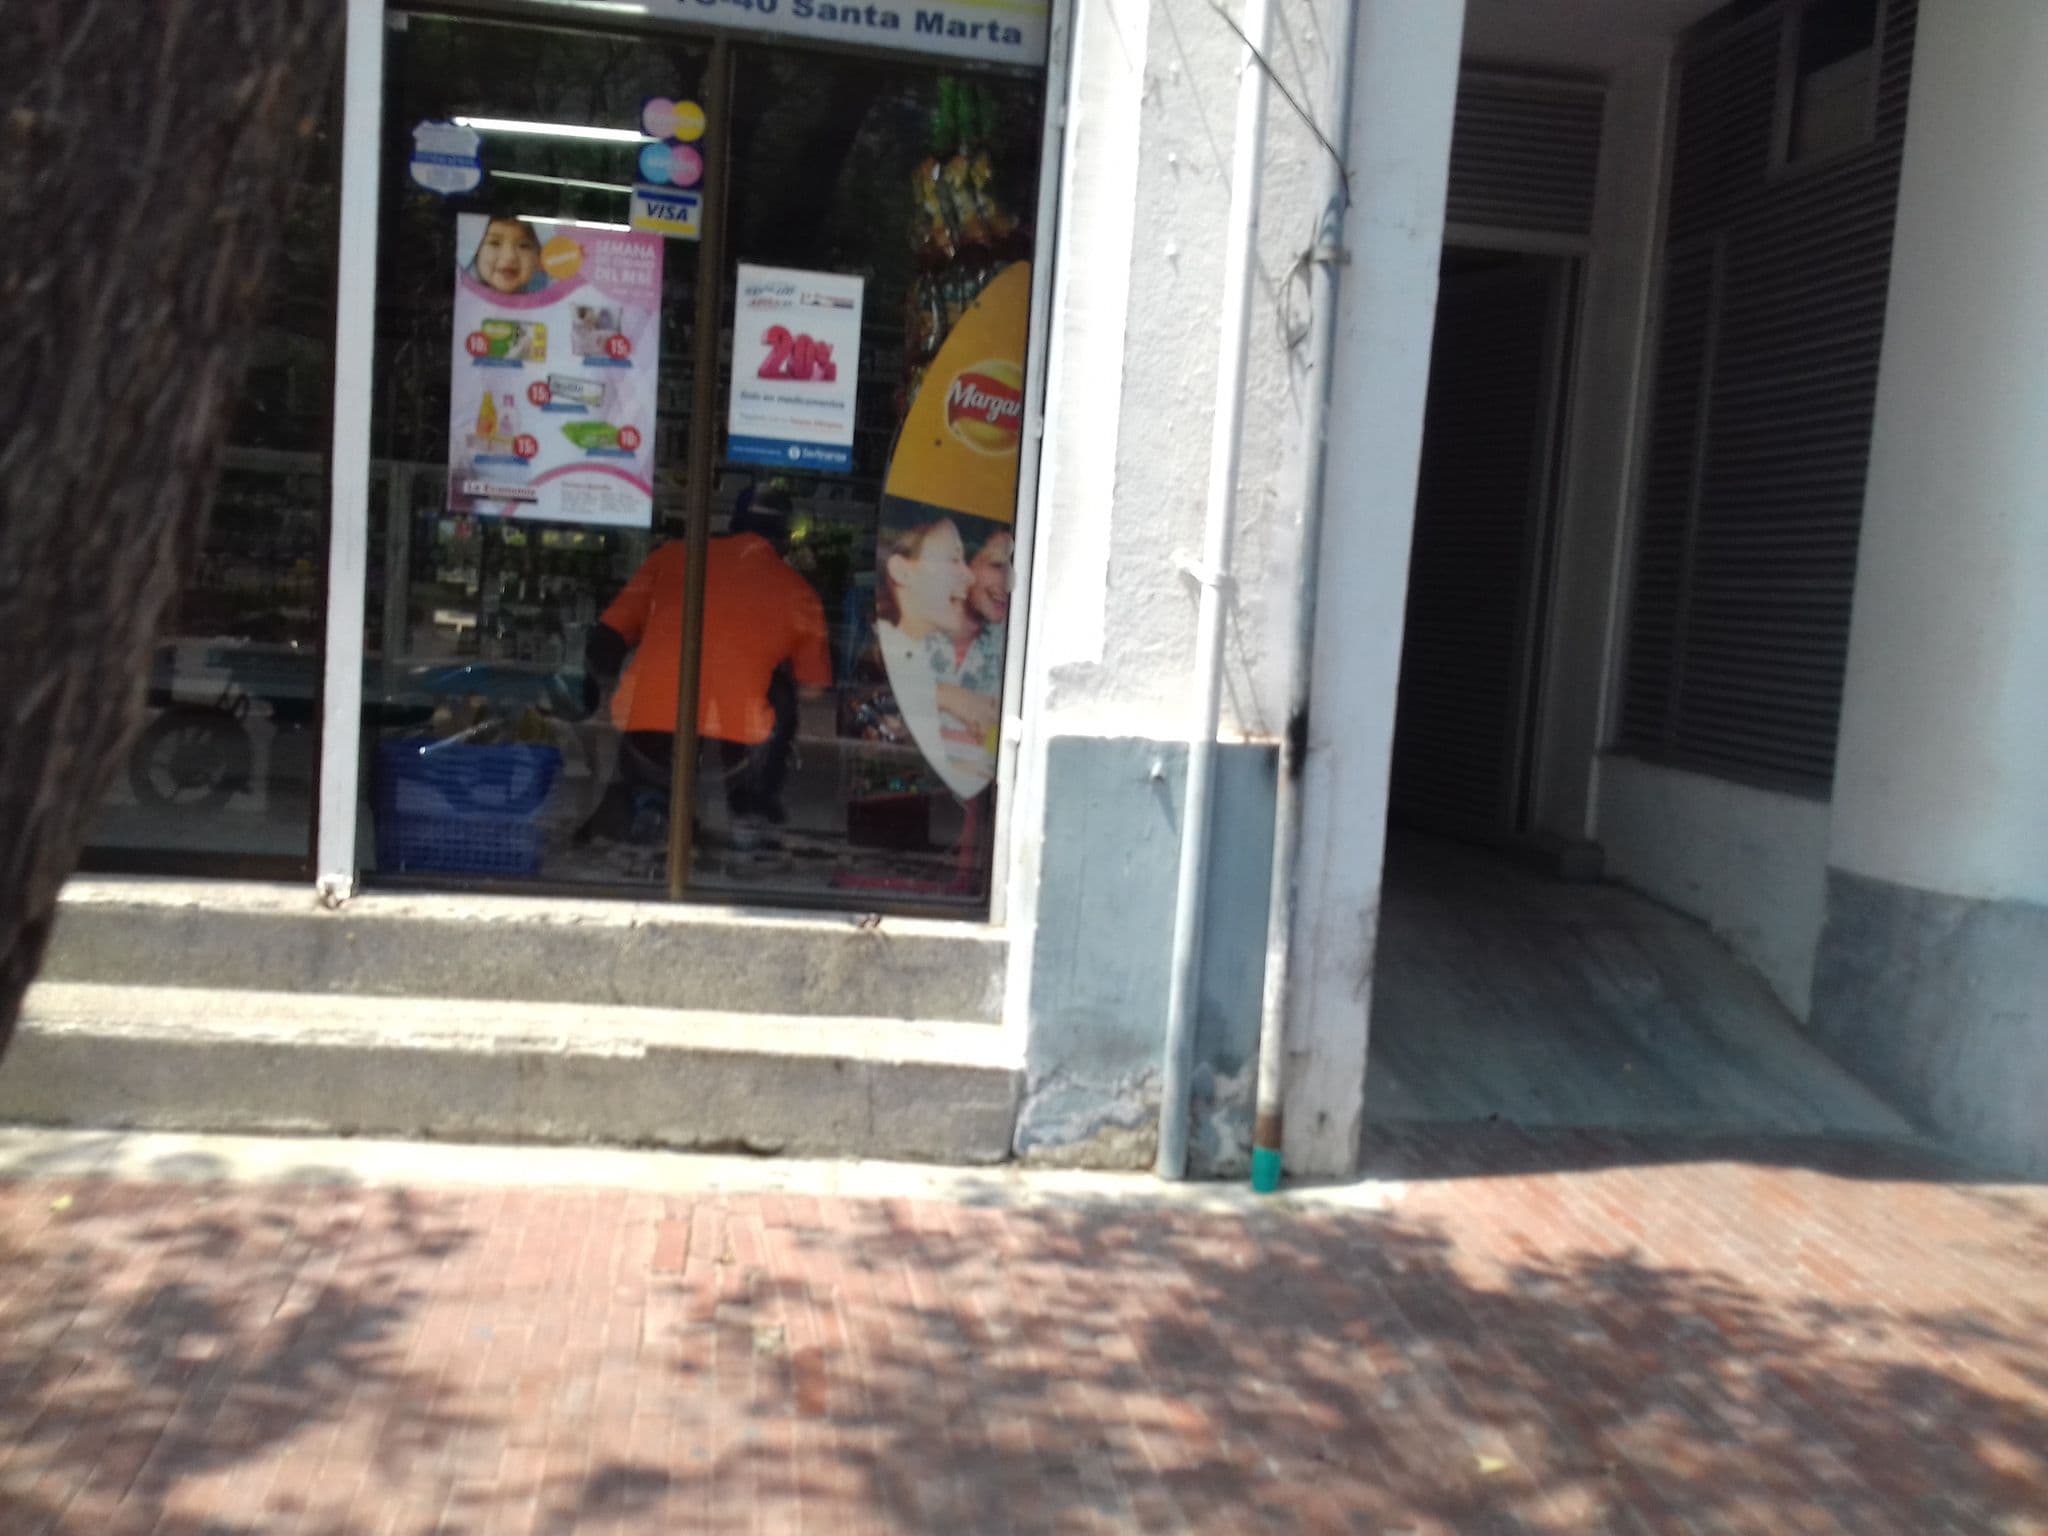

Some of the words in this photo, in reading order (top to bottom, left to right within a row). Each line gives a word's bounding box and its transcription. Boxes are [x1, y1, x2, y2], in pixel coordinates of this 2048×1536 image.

[792, 0, 901, 31] Santa
[914, 10, 1023, 46] Marta
[646, 202, 688, 221] VISA
[758, 324, 838, 383] 20%
